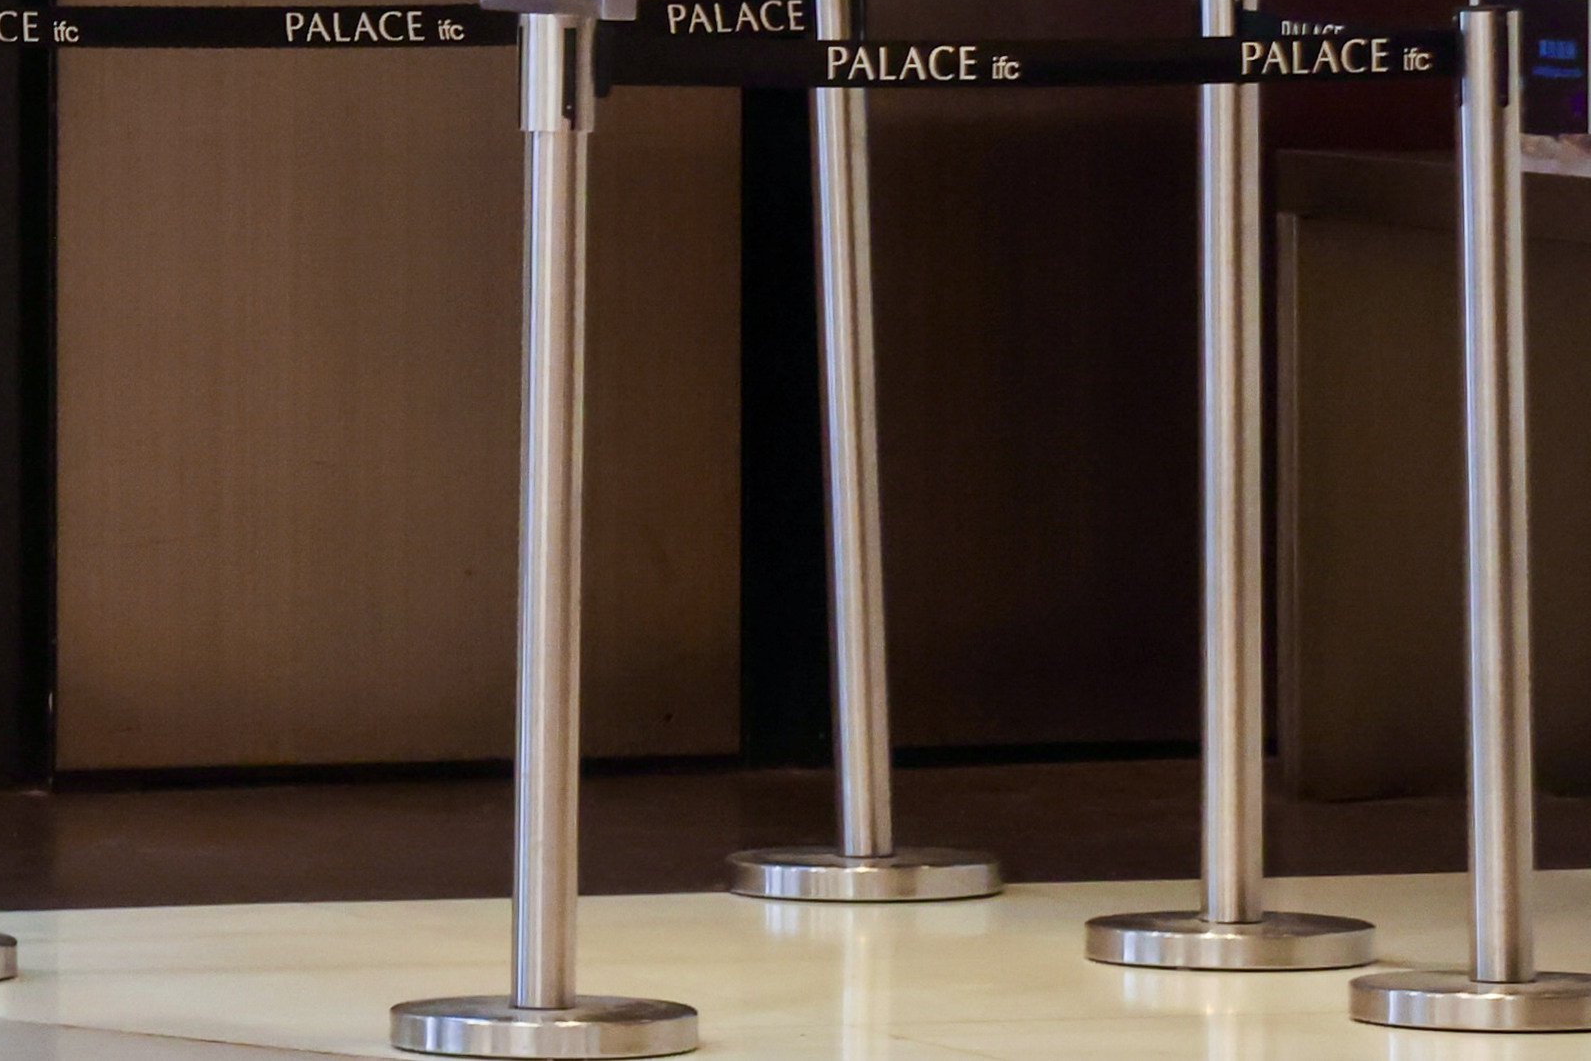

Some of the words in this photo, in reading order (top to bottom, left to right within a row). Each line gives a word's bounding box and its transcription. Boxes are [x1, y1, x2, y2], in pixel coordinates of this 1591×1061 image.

[53, 20, 80, 43] ifc
[286, 11, 425, 42] PALACE
[437, 19, 465, 41] ifc
[666, 0, 805, 34] PALACE
[827, 45, 977, 81] PALACE
[992, 56, 1020, 80] ifc
[1241, 38, 1390, 75] PALACE
[1403, 47, 1433, 71] ifc
